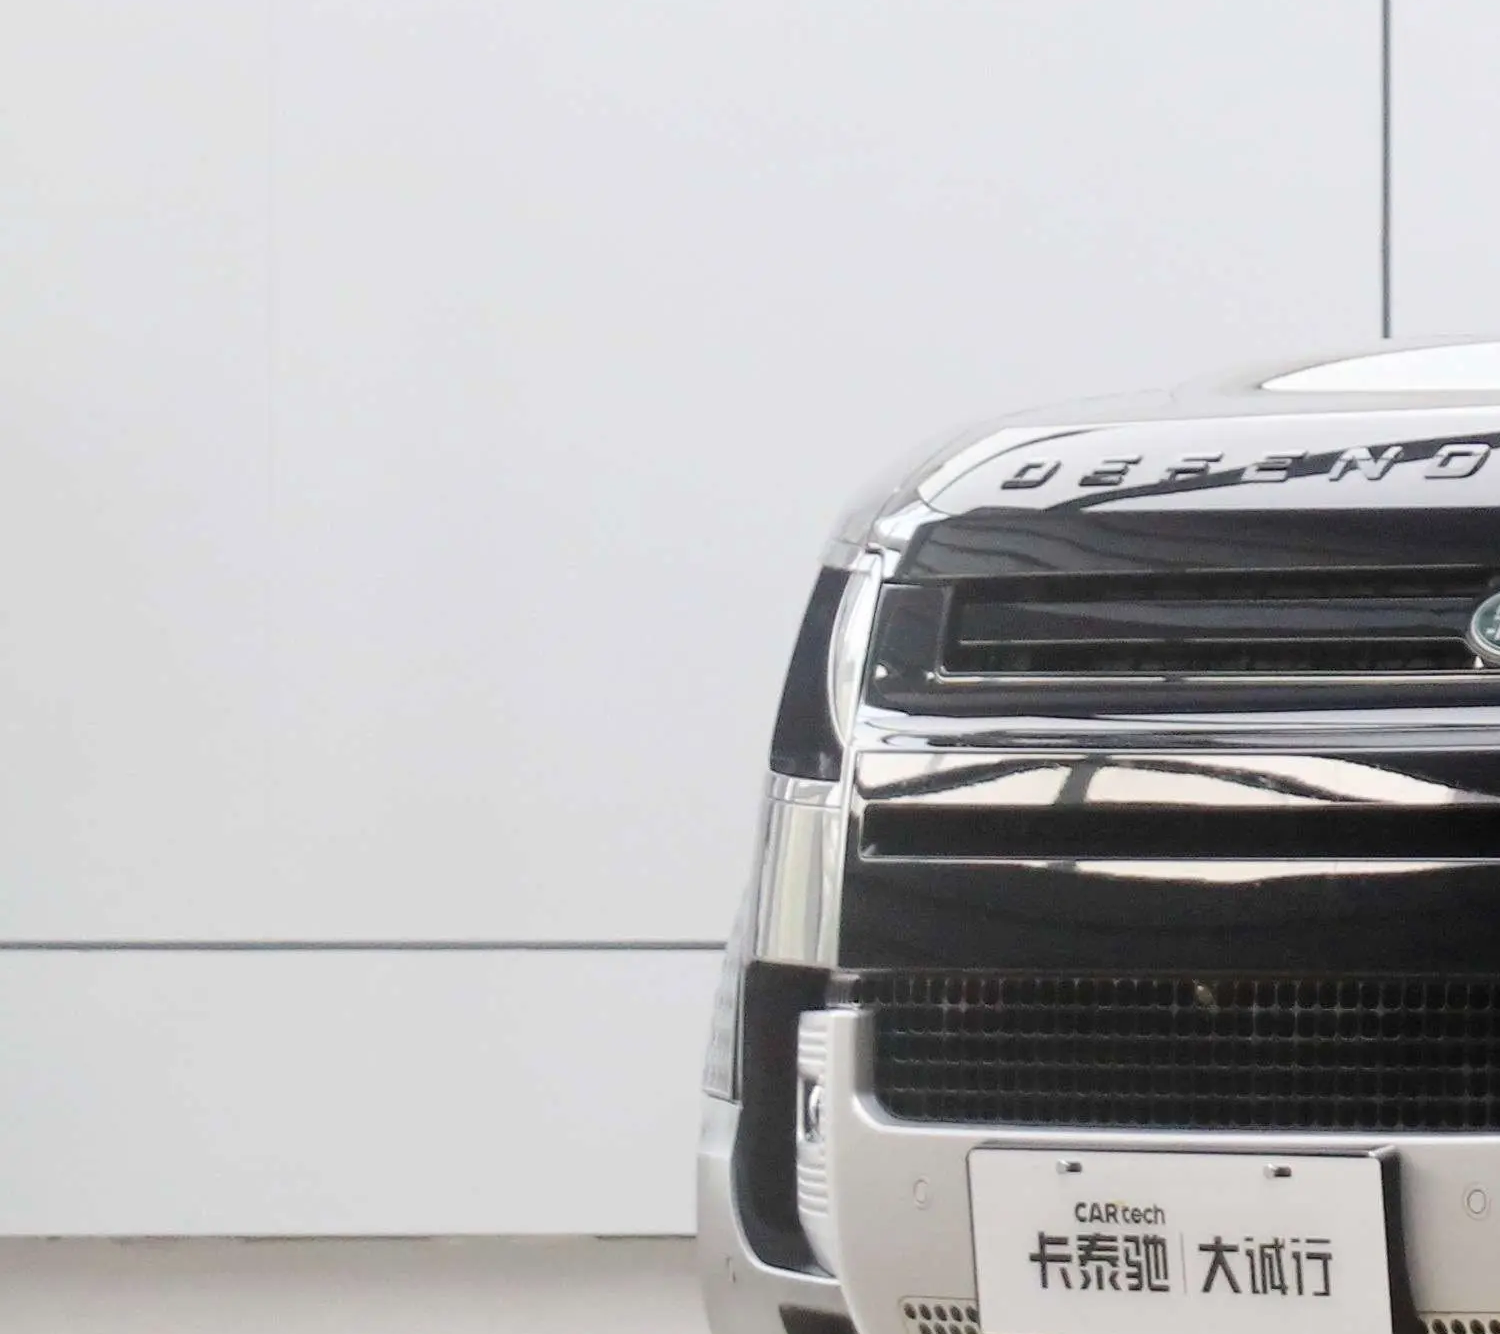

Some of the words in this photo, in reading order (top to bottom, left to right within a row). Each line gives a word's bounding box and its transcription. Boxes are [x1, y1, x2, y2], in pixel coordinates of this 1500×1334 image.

[1074, 1201, 1166, 1225] CARtech
[1029, 1231, 1170, 1293] 卡泰驰
[1198, 1235, 1333, 1297] 大诚行
